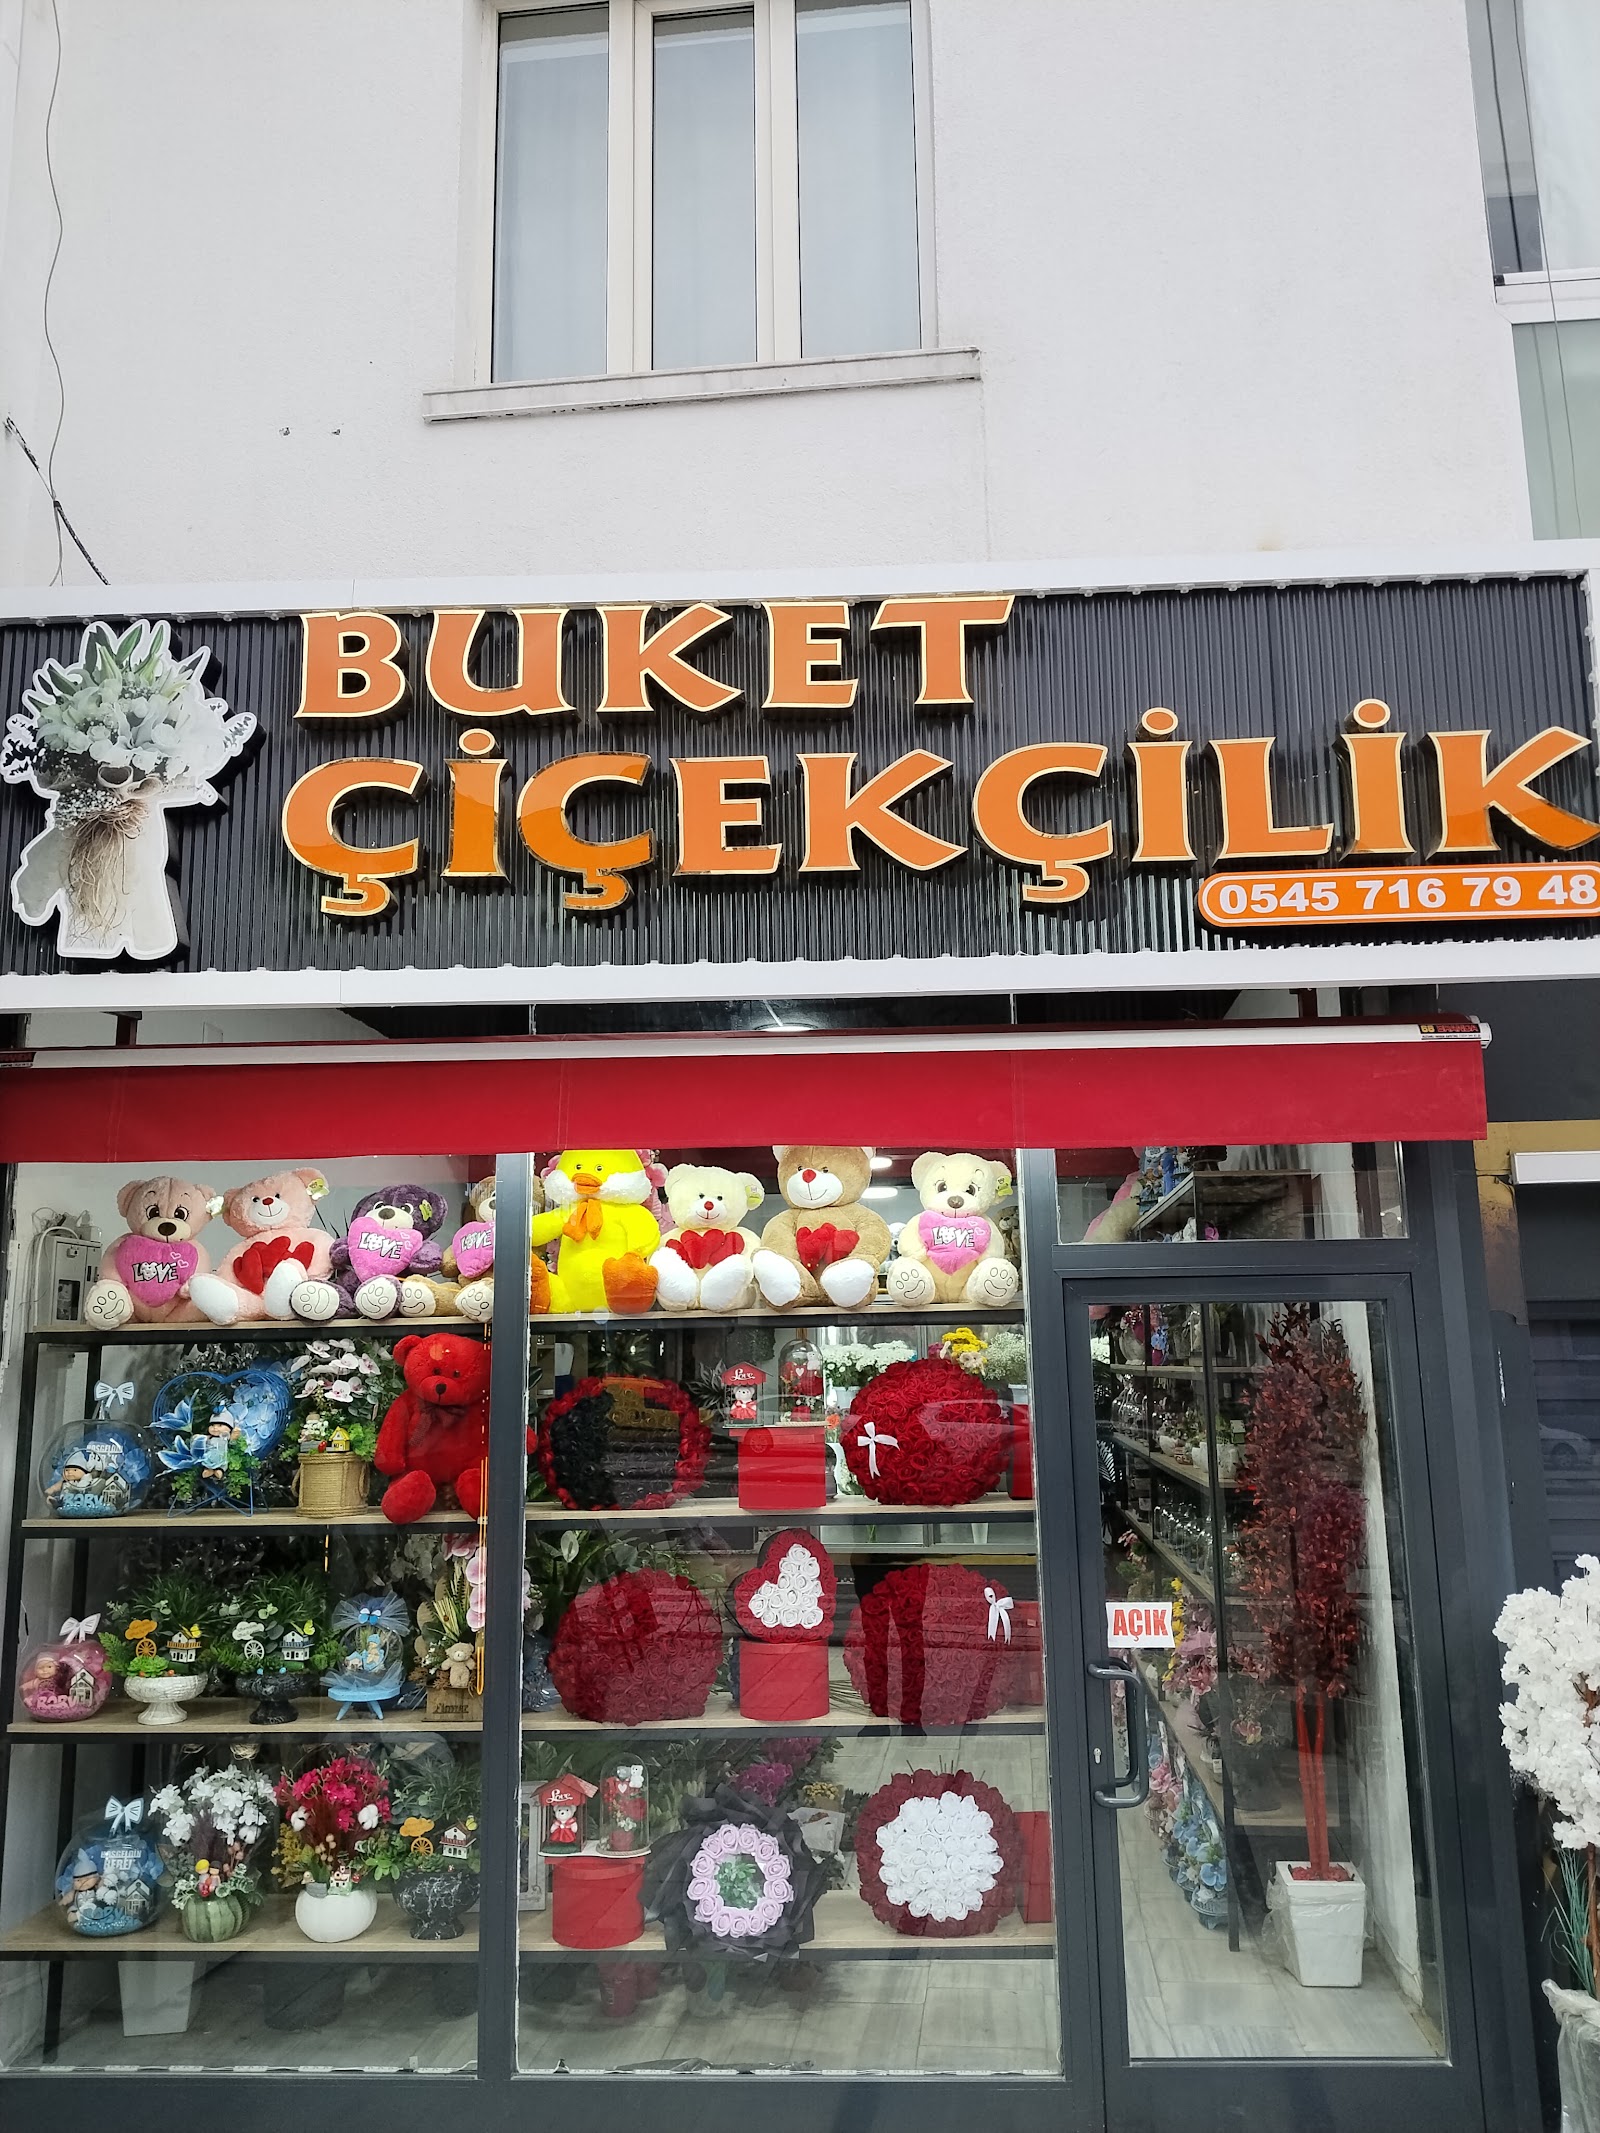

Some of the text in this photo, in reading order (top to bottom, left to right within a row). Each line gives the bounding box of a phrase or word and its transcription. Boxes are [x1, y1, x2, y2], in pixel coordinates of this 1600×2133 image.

[293, 595, 1015, 720] BUKET
[282, 698, 1600, 917] ÇİÇEKÇİLİK
[1219, 874, 1598, 915] 0545 716 79 48
[358, 1231, 403, 1260] LOVE
[461, 1229, 492, 1253] LOVE
[932, 1225, 975, 1248] LOVE
[132, 1261, 178, 1283] LOVE
[730, 1368, 755, 1382] Love
[1113, 1609, 1169, 1642] AÇIK
[546, 1789, 573, 1803] Love
